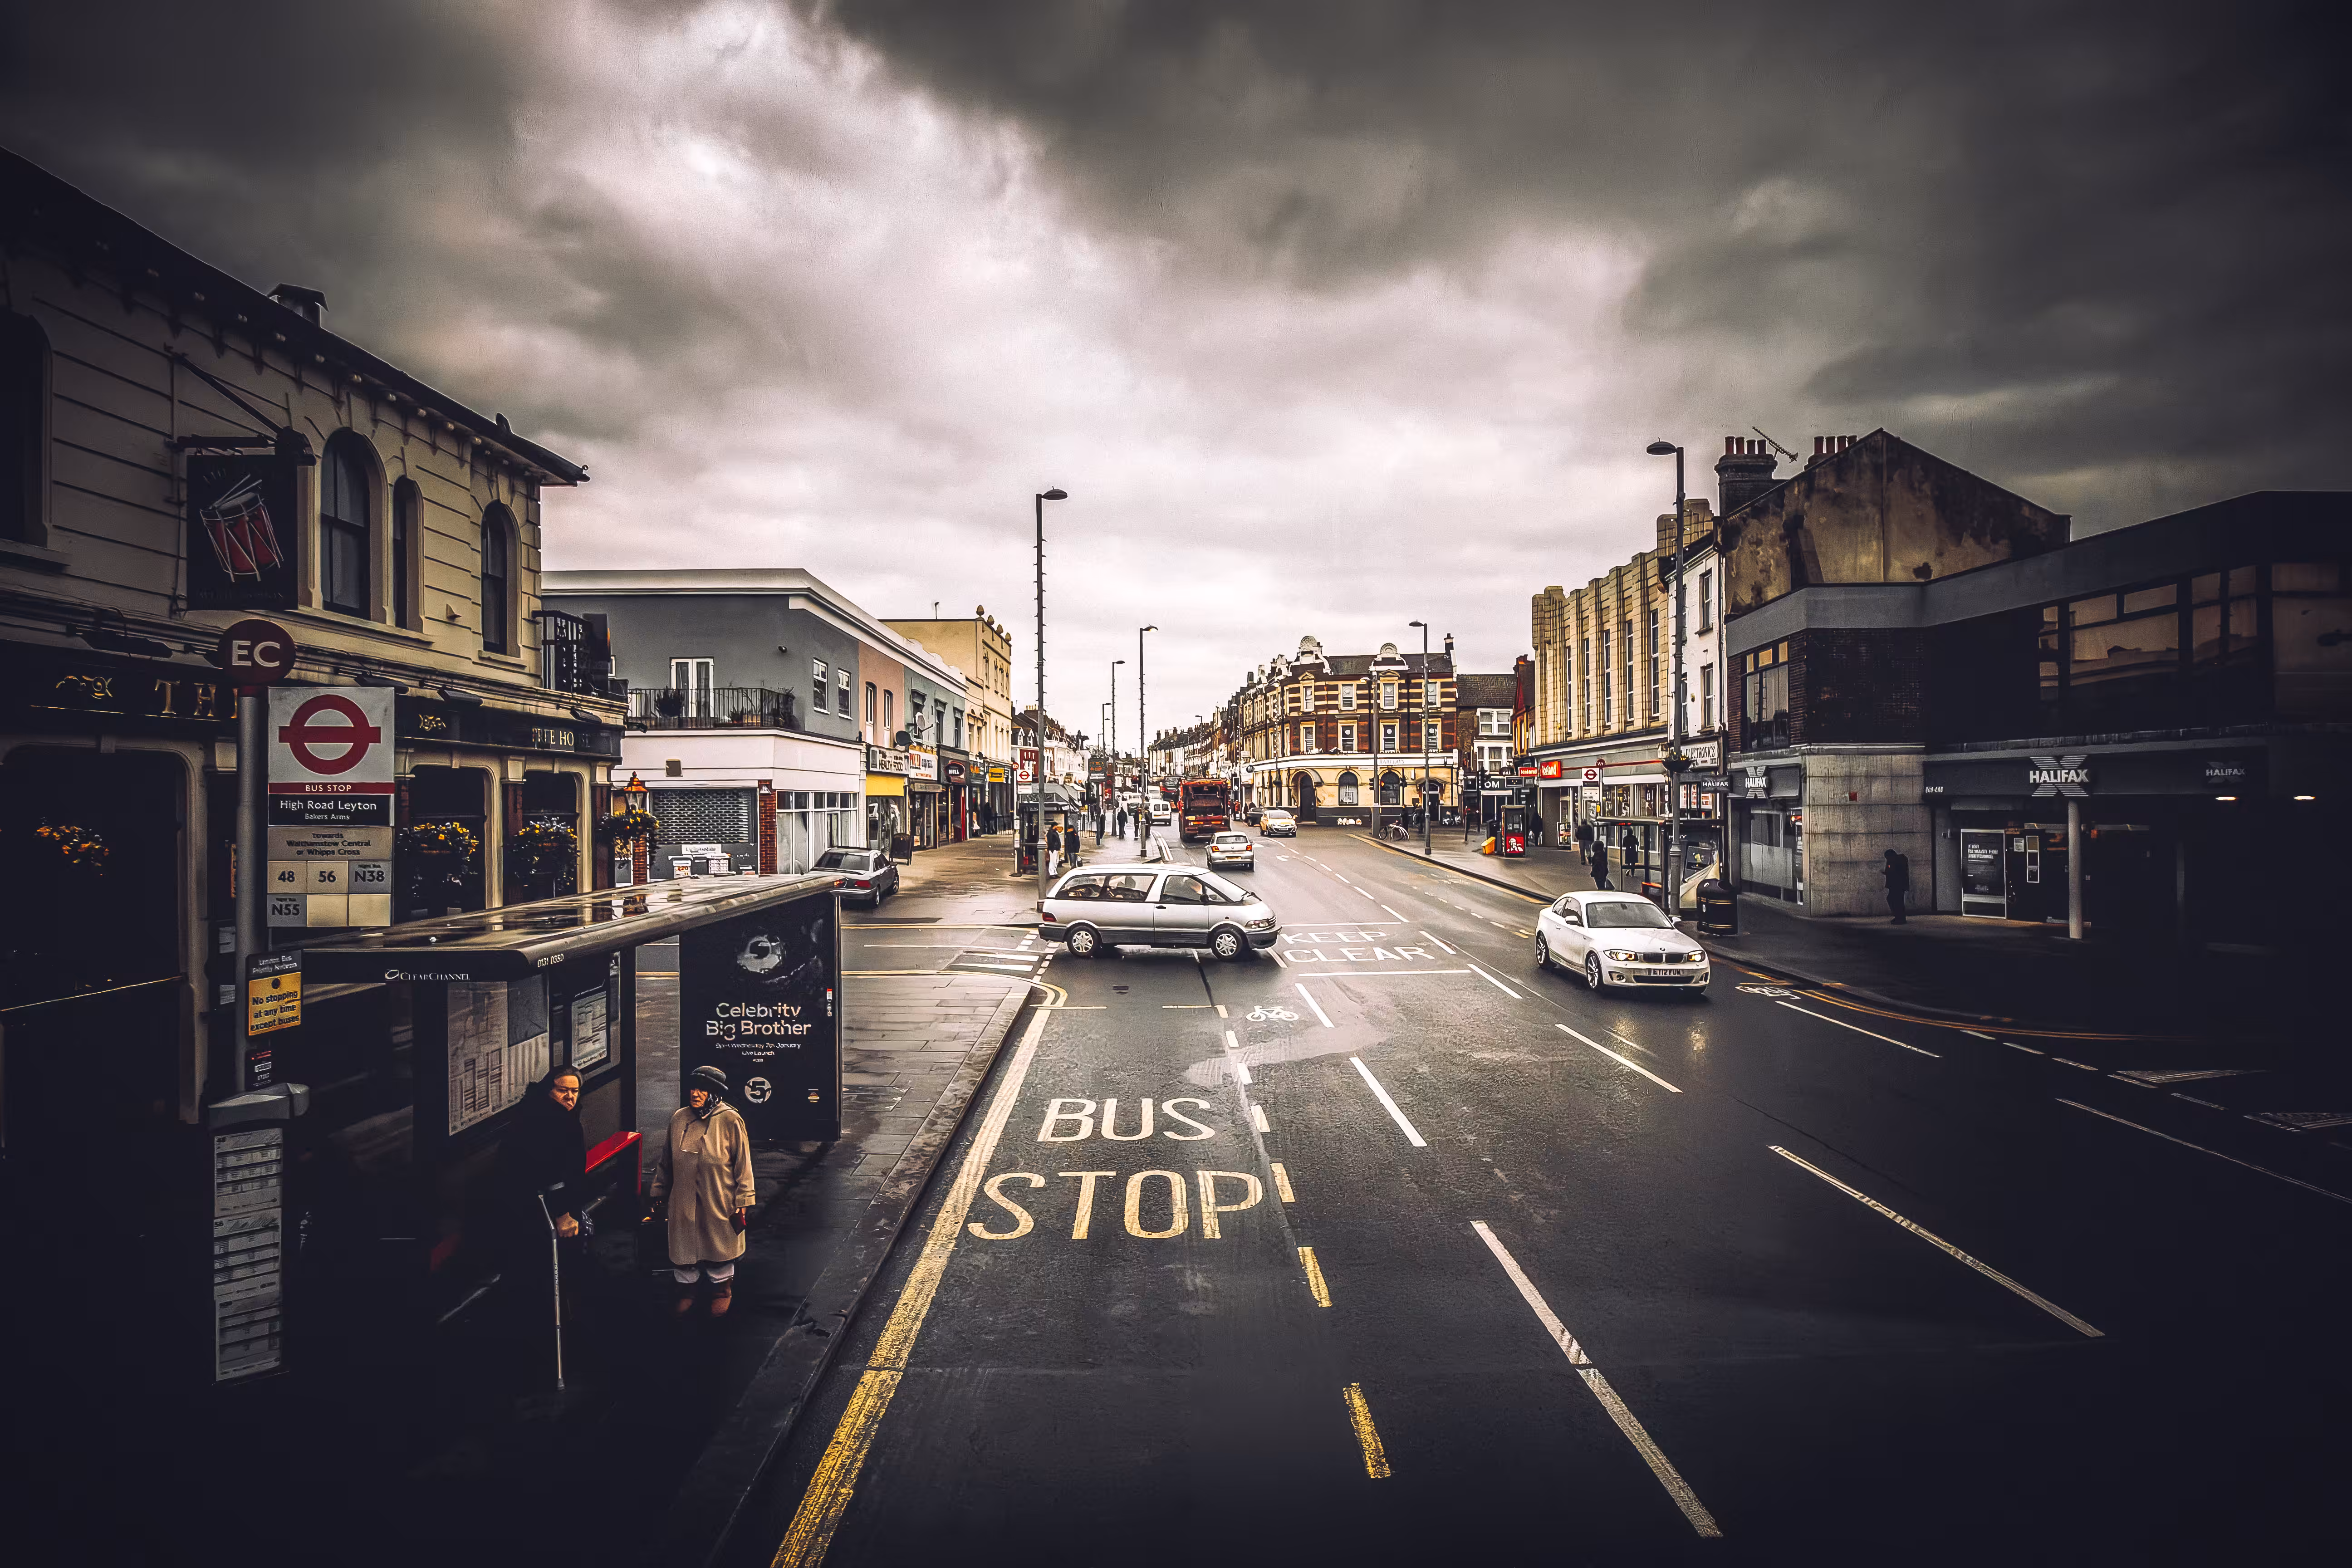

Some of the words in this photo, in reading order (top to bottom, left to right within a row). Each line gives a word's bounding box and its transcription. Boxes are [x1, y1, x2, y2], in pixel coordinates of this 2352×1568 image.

[231, 640, 280, 667] EC
[1542, 763, 1557, 776] Iceland
[2029, 769, 2089, 784] HALIFAX
[1745, 777, 1767, 788] HALIFAX
[280, 800, 304, 811] High
[308, 800, 334, 809] Road
[338, 800, 377, 812] Leyton
[277, 870, 295, 883] 48
[318, 870, 337, 883] 56
[354, 870, 385, 882] N38
[271, 903, 300, 916] N55
[1280, 930, 1387, 943] KEEP
[1283, 946, 1436, 963] CLEAR
[252, 996, 264, 1006] No
[265, 991, 298, 1003] stopping
[254, 1009, 262, 1019] at
[264, 1008, 278, 1016] any
[279, 1004, 296, 1013] time
[716, 1002, 802, 1019] Celebrity
[250, 1019, 277, 1031] except
[278, 1015, 299, 1025] buses
[706, 1020, 736, 1041] Big
[741, 1019, 812, 1035] Brother
[1037, 1098, 1215, 1142] BUS
[968, 1169, 1263, 1240] STOP
